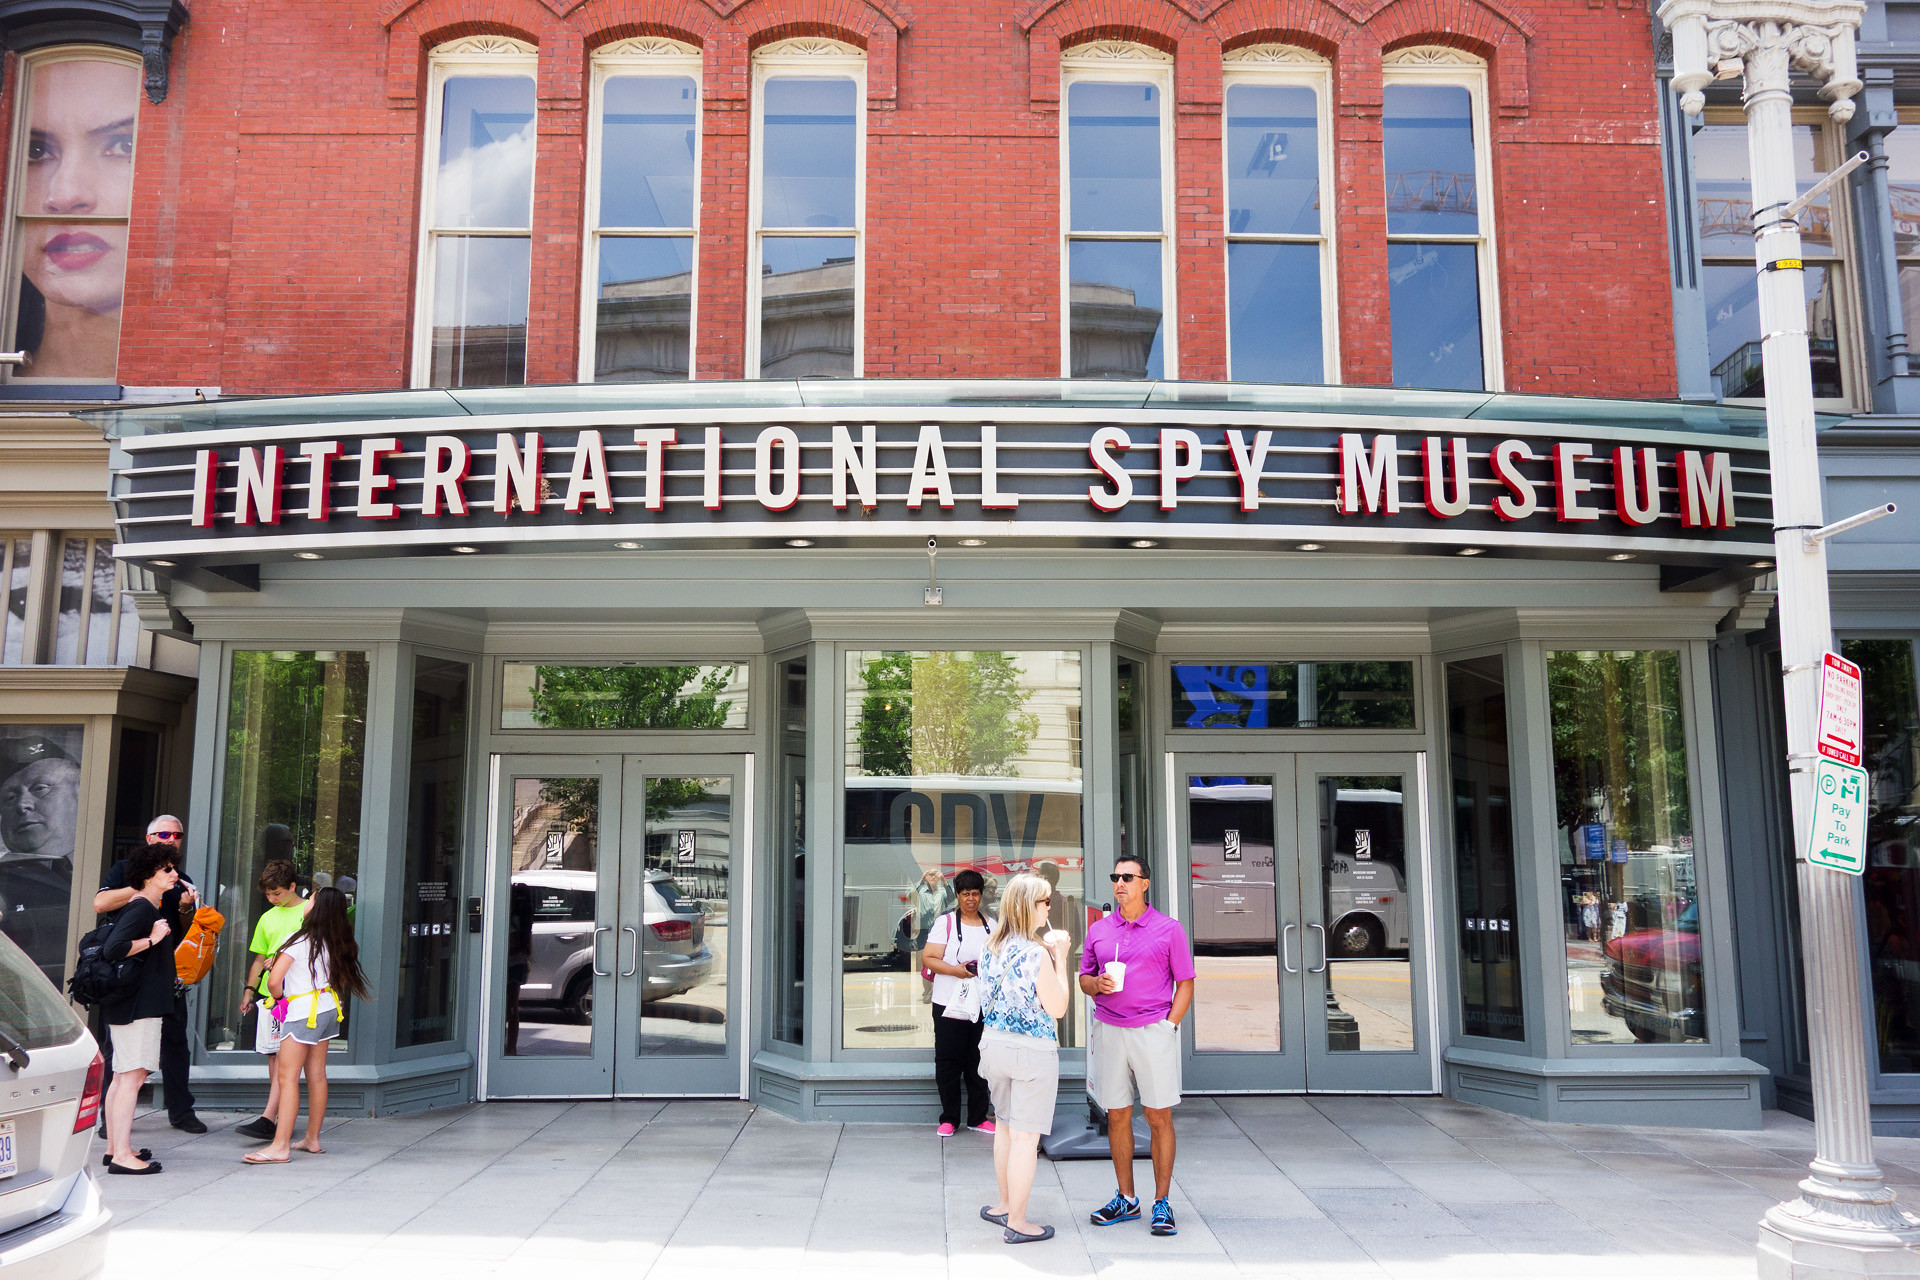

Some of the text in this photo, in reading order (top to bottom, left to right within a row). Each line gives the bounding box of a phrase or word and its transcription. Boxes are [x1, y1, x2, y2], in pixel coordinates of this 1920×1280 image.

[191, 424, 1737, 529] INTERNATIONAL SPY MUSEUM
[1827, 670, 1857, 691] NO PARKING
[1832, 803, 1851, 819] Pay
[1834, 820, 1847, 832] To
[547, 833, 563, 849] SPY
[680, 832, 694, 849] SPY
[1224, 831, 1239, 847] SPY
[1355, 831, 1370, 847] SPY
[1827, 832, 1851, 847] Park
